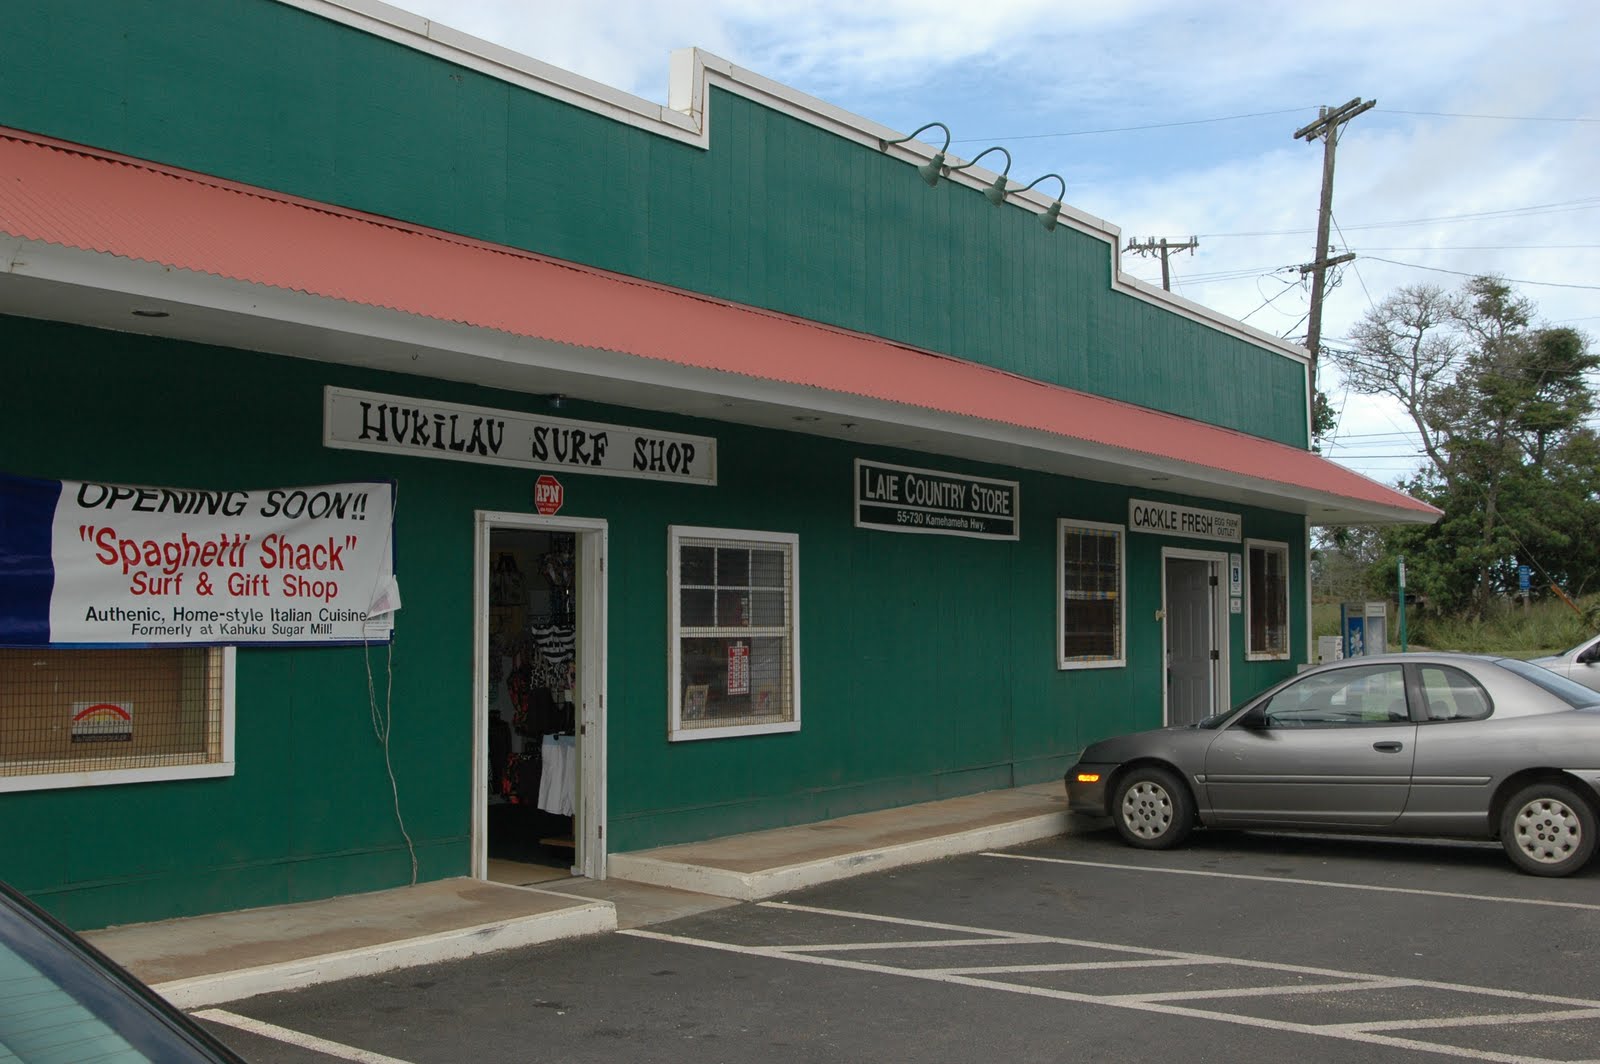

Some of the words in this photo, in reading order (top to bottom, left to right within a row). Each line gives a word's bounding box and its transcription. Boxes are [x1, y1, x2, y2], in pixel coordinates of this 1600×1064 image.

[358, 401, 505, 456] HUKILAU
[532, 426, 608, 466] SURF
[633, 437, 695, 475] SHOP
[77, 483, 250, 516] OPENING
[260, 490, 368, 521] SOON!!
[536, 484, 560, 503] APN
[865, 468, 899, 502] LAIE
[904, 474, 966, 509] COUNTRY
[971, 483, 1010, 514] STORE
[896, 510, 924, 524] 55-730
[925, 513, 968, 528] Kamehameha
[970, 518, 986, 532] Hwy.
[1134, 506, 1177, 530] CACKLE
[1181, 513, 1213, 534] FRESH
[1214, 517, 1225, 526] EGG
[1217, 527, 1236, 536] OUTLET
[79, 525, 251, 575] "Spaghetti
[259, 533, 357, 571] Shack"
[129, 571, 183, 596] Surf
[195, 571, 213, 596] &
[227, 572, 270, 597] Gift
[282, 574, 338, 603] Shop
[85, 606, 165, 624] Authenic,
[173, 607, 263, 625] Home-style
[270, 608, 312, 622] Italian
[318, 608, 367, 622] Cuisine
[131, 623, 192, 637] Formerly
[200, 624, 213, 635] at
[220, 623, 266, 635] Kahuku
[272, 624, 304, 637] Sugar
[310, 623, 333, 635] Mill!
